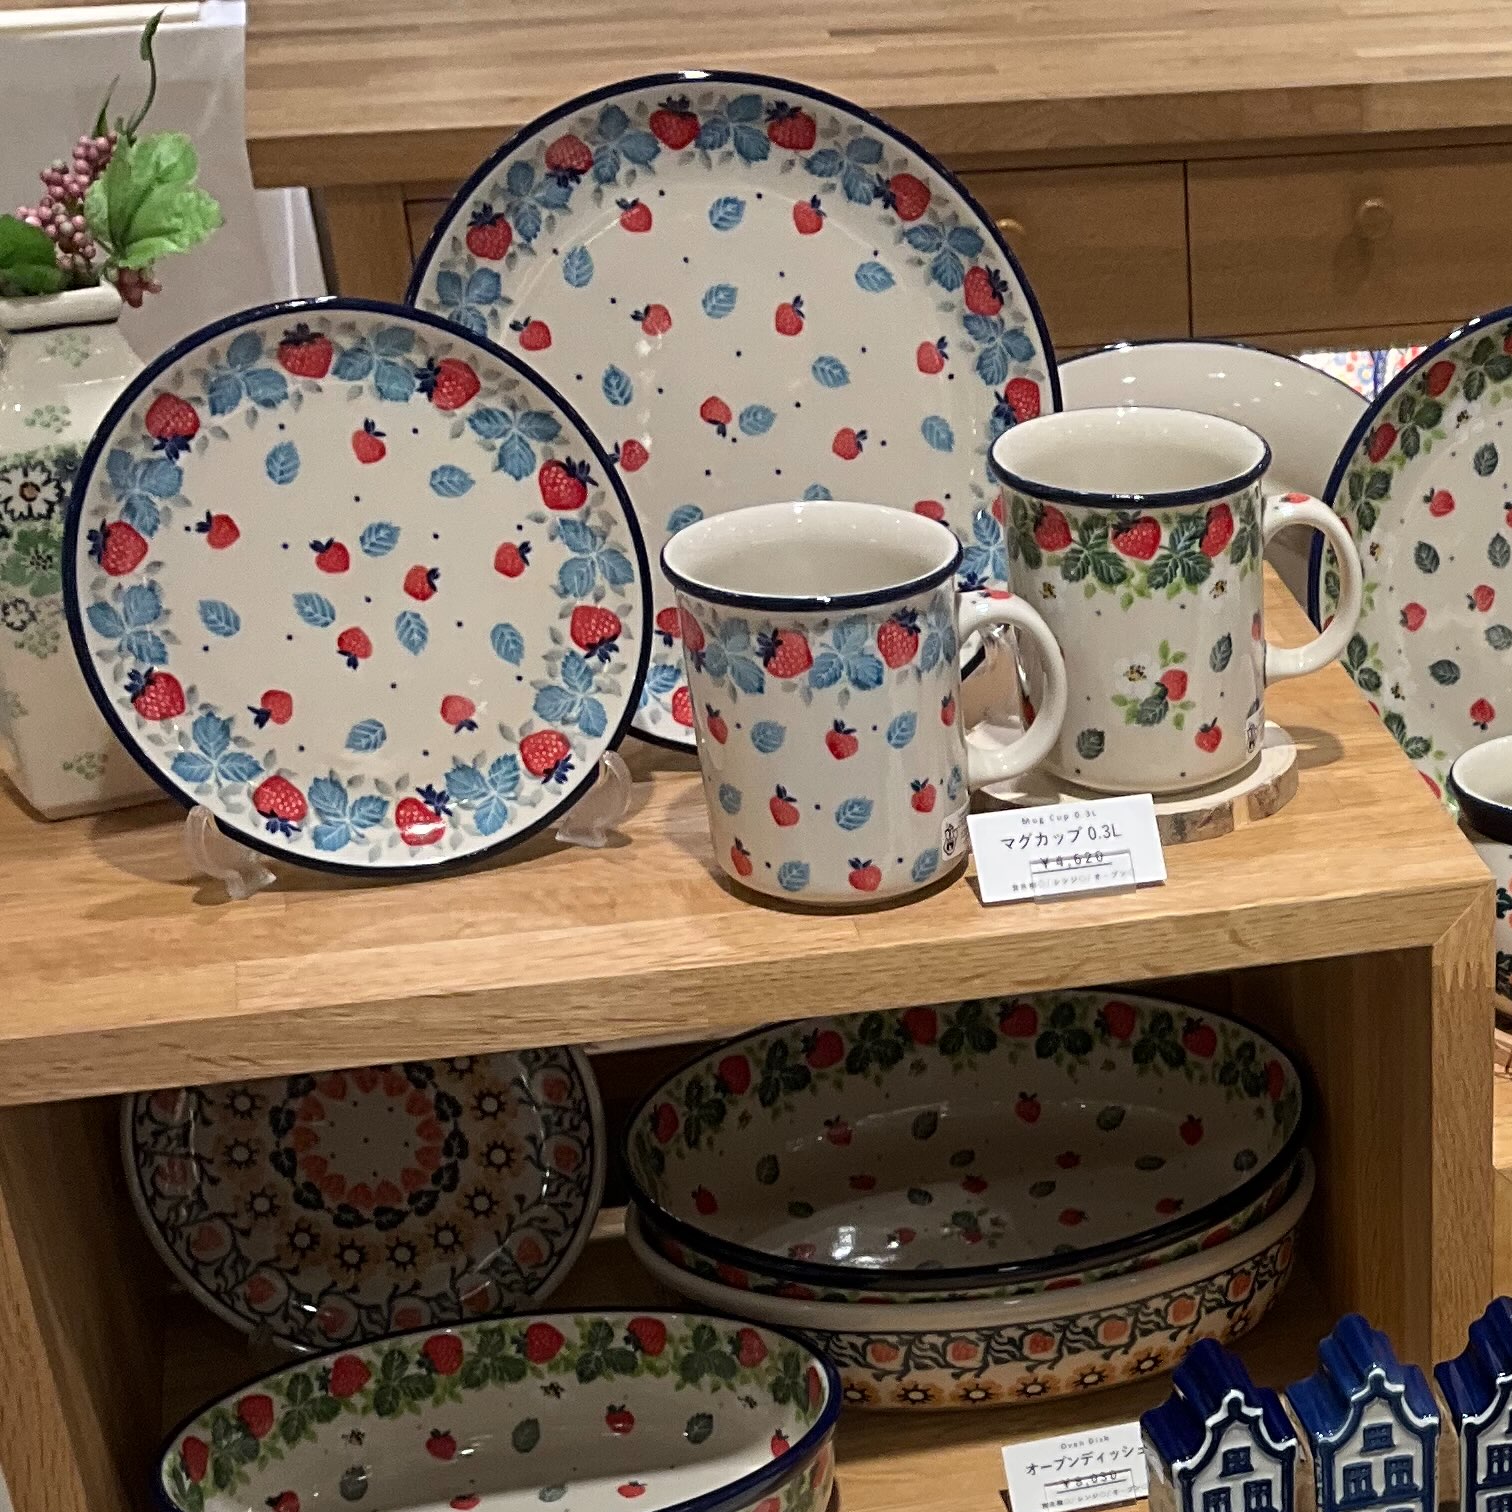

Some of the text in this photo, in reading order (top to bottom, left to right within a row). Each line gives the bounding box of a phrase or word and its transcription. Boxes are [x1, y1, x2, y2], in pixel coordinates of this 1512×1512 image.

[1021, 815, 1044, 825] Mug
[1049, 813, 1069, 822] Cup
[1061, 1435, 1110, 1450] Oven Dish
